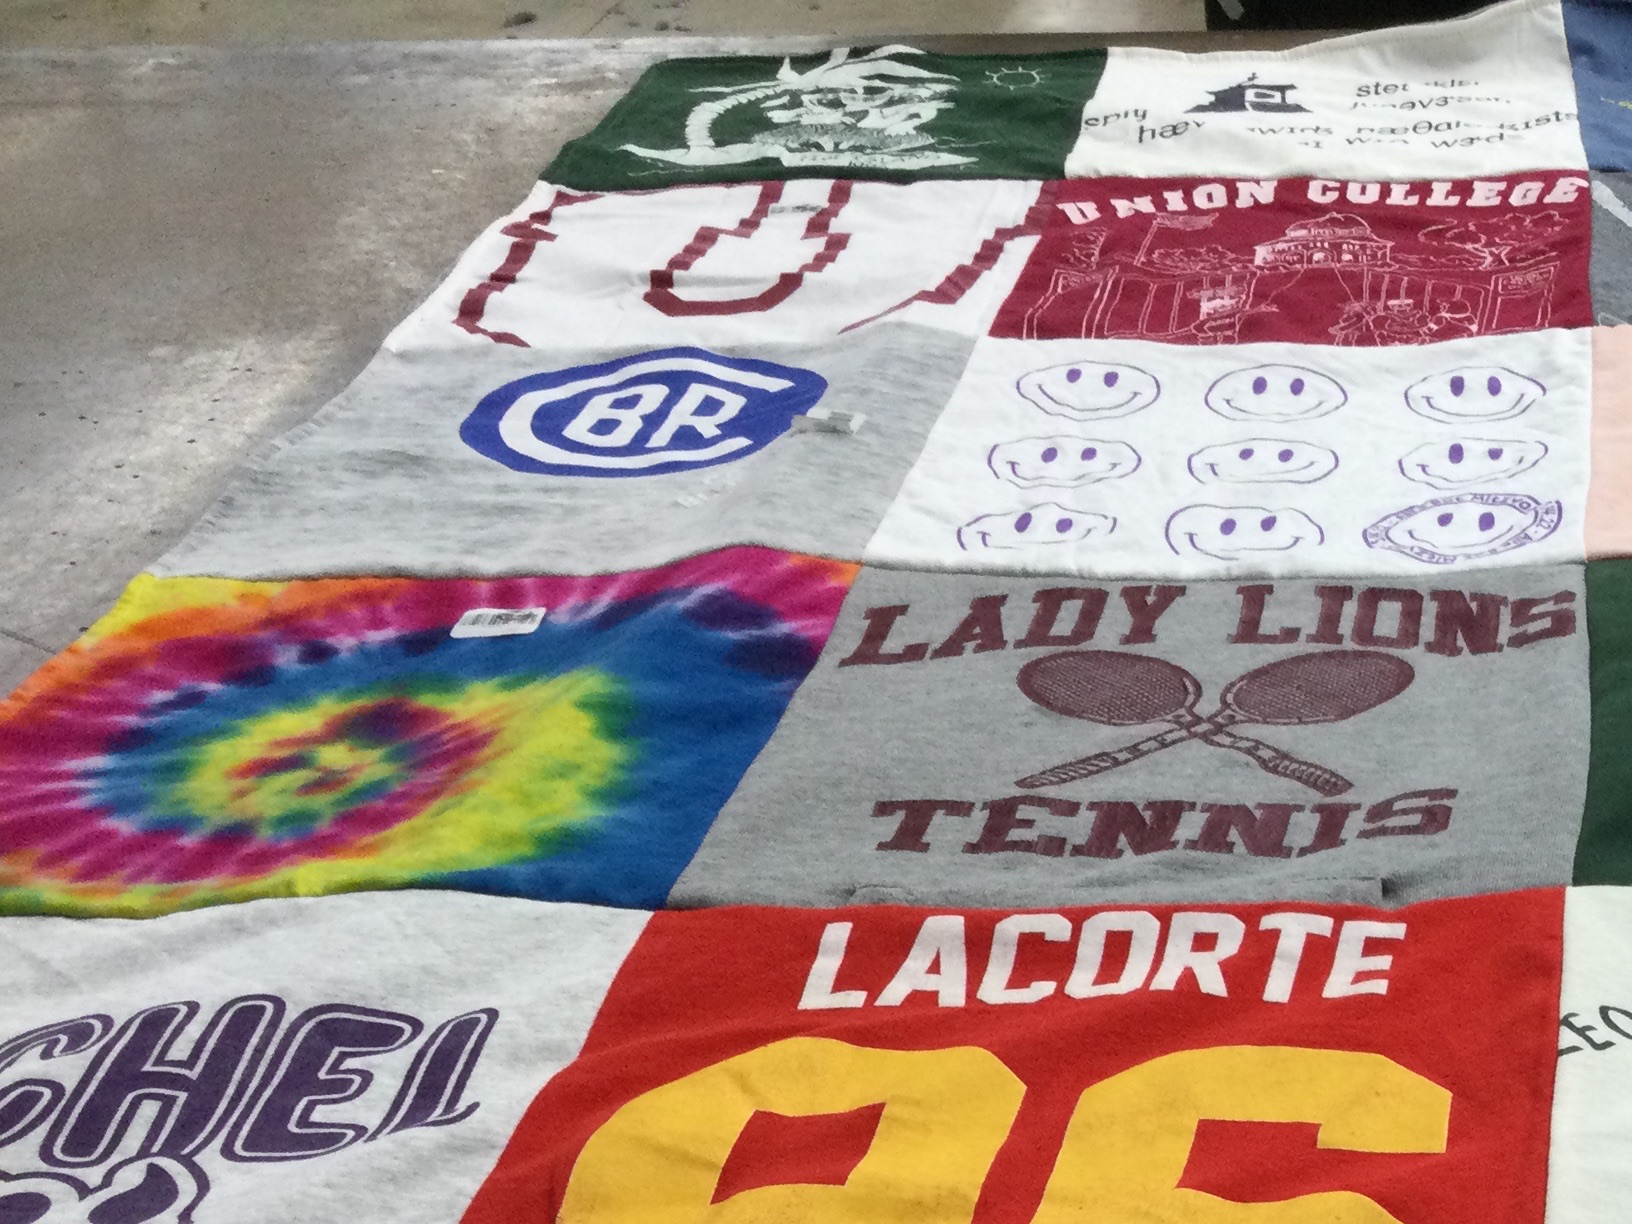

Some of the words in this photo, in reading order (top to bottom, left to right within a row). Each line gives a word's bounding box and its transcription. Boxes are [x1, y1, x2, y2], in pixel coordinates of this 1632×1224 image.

[1057, 180, 1278, 226] UNION
[1307, 177, 1588, 208] COLLEGE
[838, 584, 1186, 668] LADY
[1229, 583, 1577, 656] LIONS
[871, 787, 1458, 860] TENNIS
[797, 911, 1408, 1011] LACORTE
